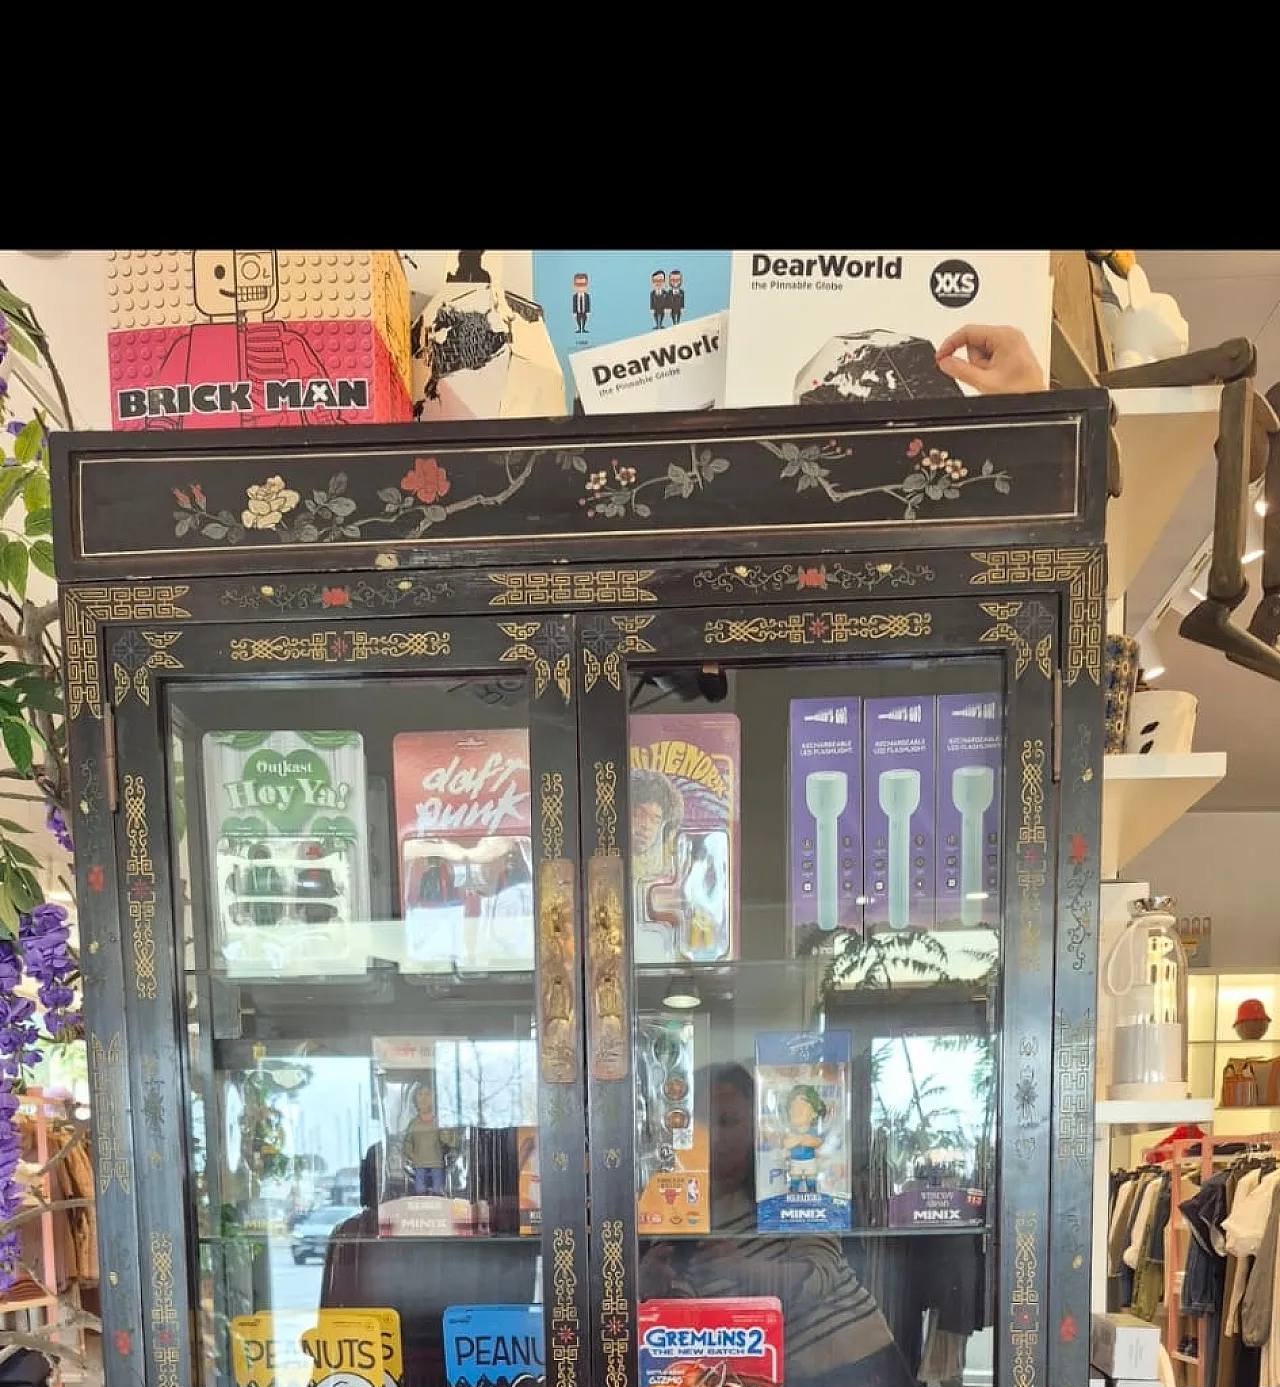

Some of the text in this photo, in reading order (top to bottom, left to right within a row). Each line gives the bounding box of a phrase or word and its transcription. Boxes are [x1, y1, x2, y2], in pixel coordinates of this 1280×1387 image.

[751, 253, 902, 279] DearWorld
[751, 281, 844, 291] the Pinnable Globe
[934, 271, 976, 293] XXS
[118, 378, 369, 420] BRICK MAN
[256, 760, 313, 776] Outkast
[422, 752, 530, 800] daft
[223, 778, 349, 811] Hey Ya!
[415, 780, 531, 837] punk
[780, 1208, 826, 1219] MINIX
[912, 1210, 960, 1220] MINIX
[244, 1338, 376, 1369] PENUTS
[747, 1329, 763, 1354] 2
